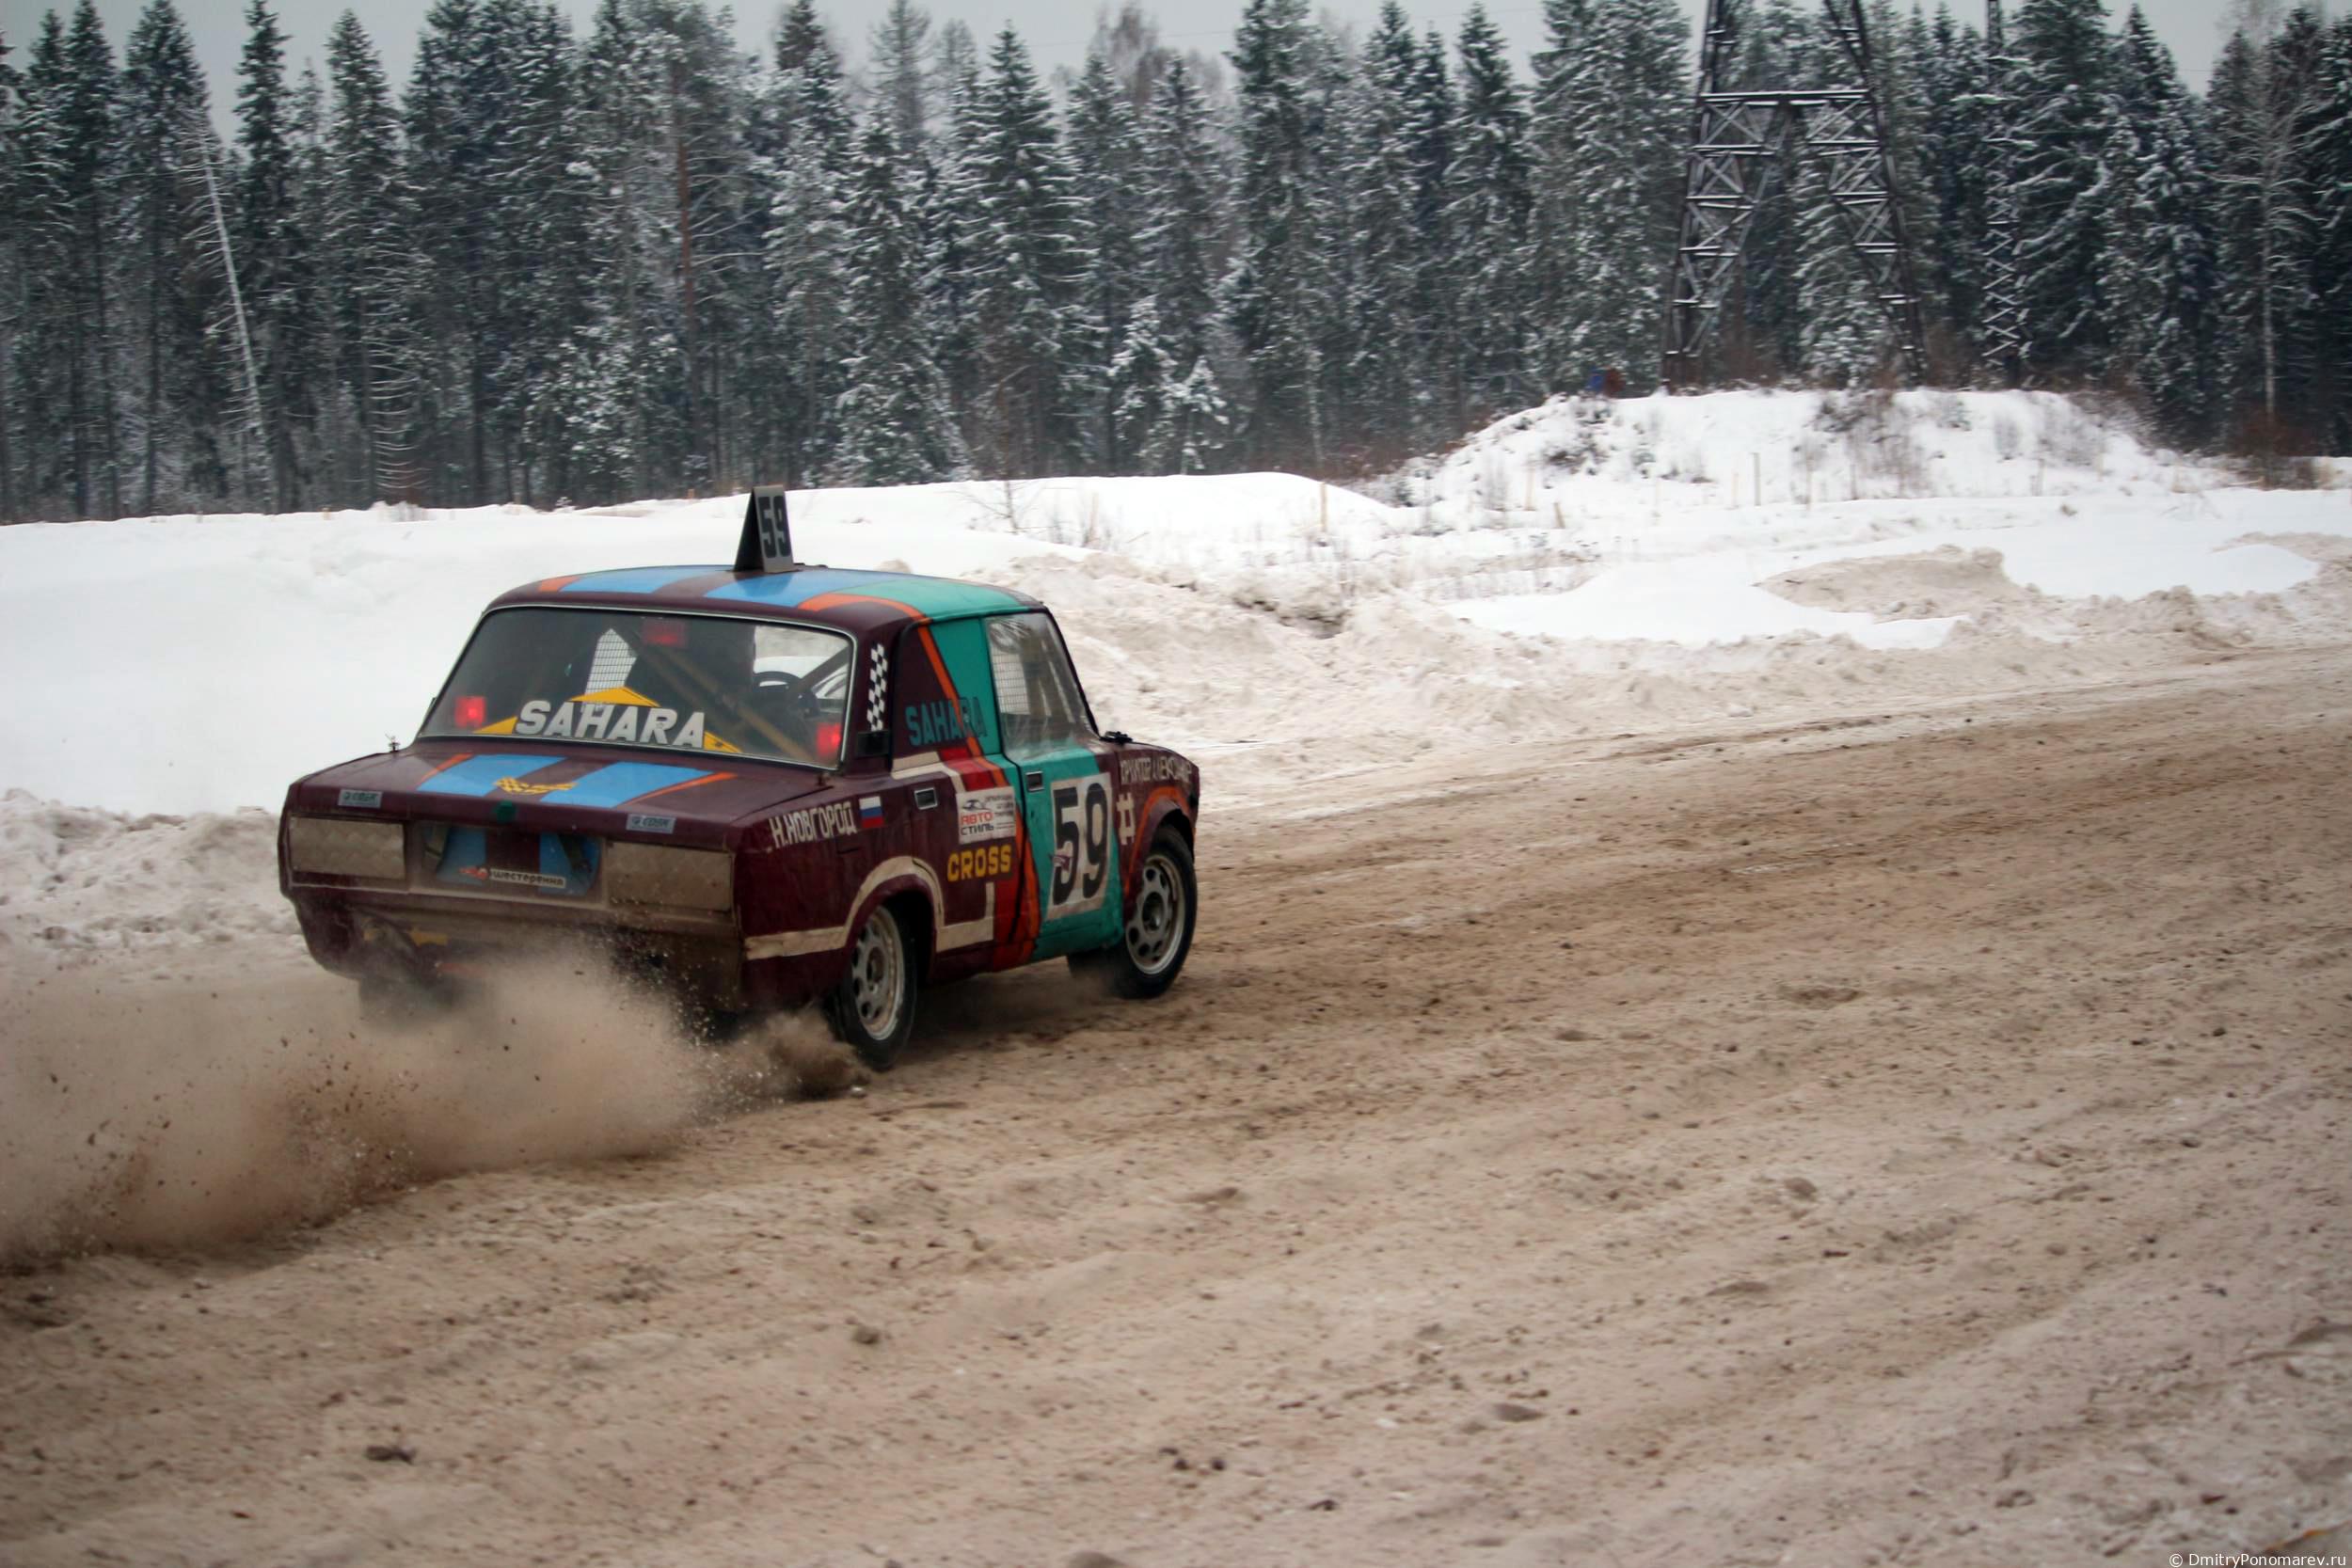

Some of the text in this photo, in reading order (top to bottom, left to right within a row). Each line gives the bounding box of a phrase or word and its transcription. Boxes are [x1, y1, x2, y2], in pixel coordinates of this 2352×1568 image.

[757, 496, 791, 559] 59
[516, 700, 705, 749] SAHARA
[905, 697, 987, 746] SAHARA
[769, 800, 857, 848] Н.НОВГОРОД
[1053, 783, 1107, 906] 59
[946, 844, 1011, 882] CROSS
